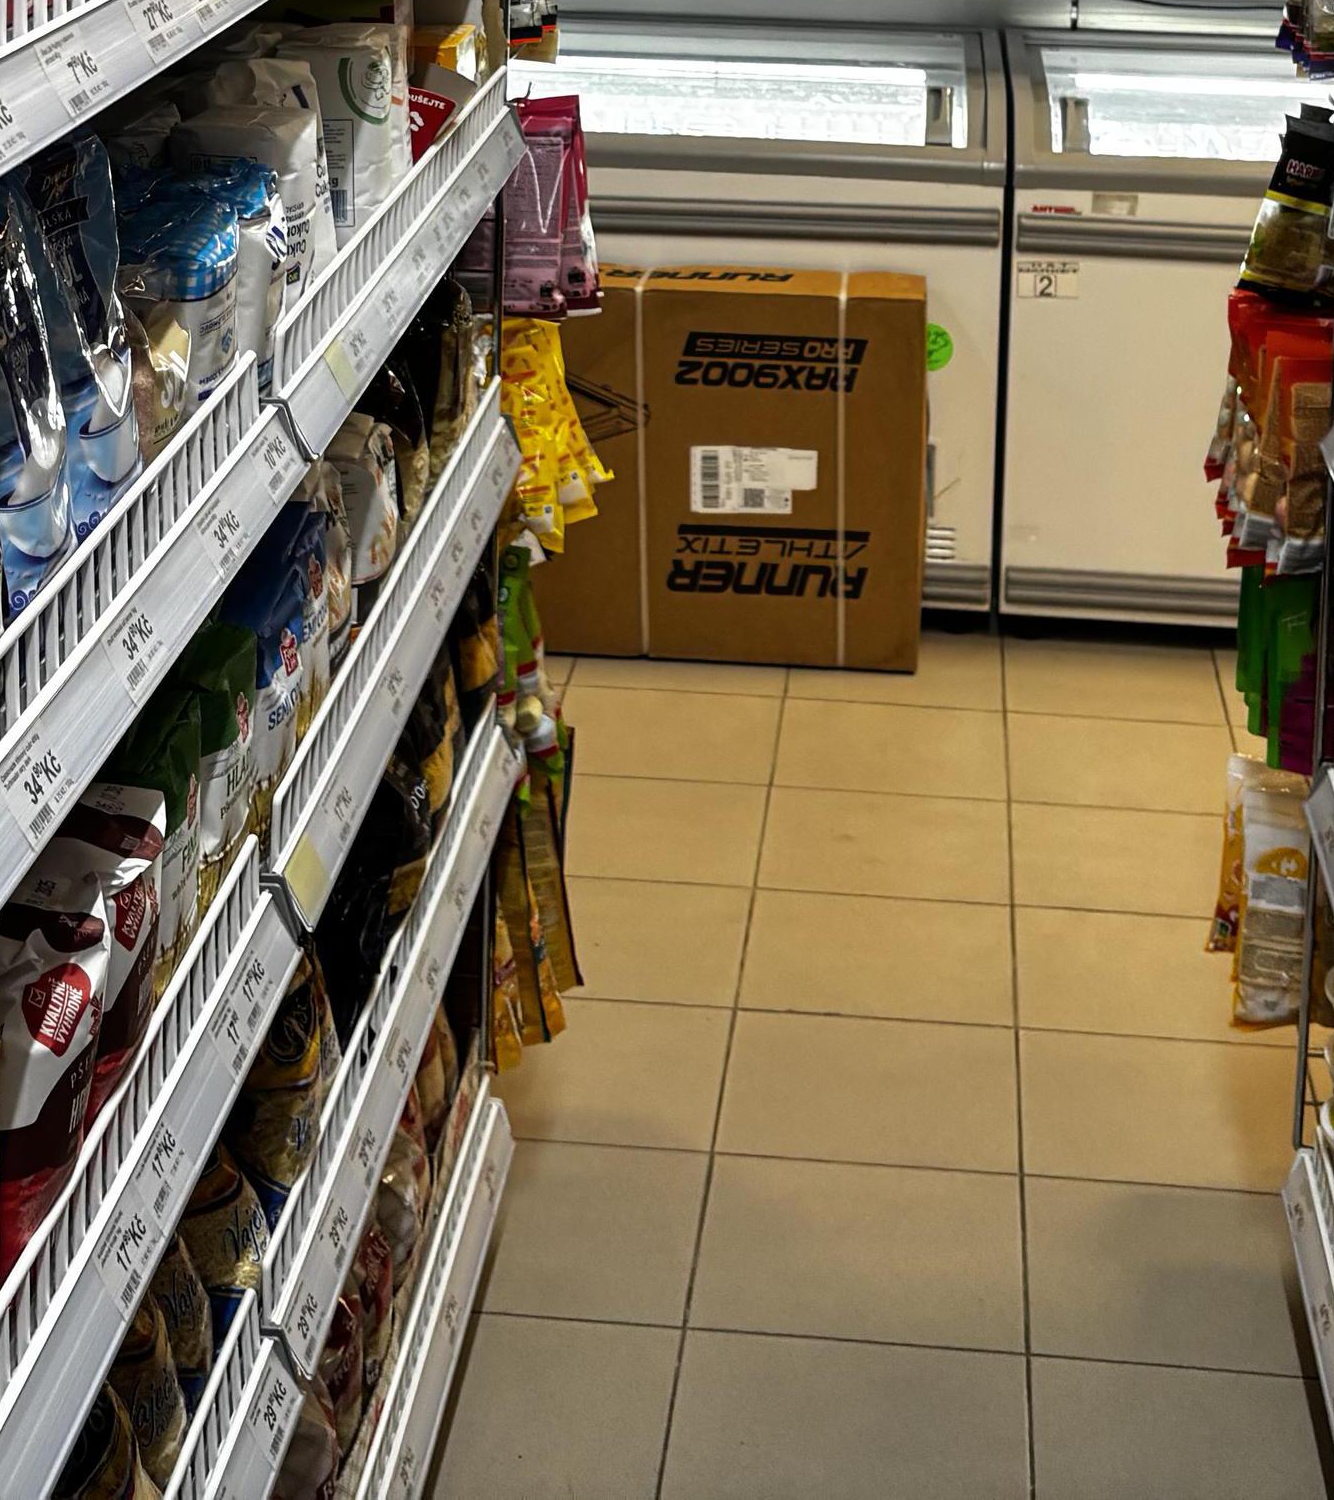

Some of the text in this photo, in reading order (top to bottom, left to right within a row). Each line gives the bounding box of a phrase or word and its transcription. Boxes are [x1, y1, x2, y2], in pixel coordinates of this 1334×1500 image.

[1038, 275, 1054, 298] 2
[695, 338, 803, 357] SERIES
[674, 359, 860, 393] RAX9002
[676, 536, 868, 560] ATHLETIX
[667, 558, 869, 600] RUNNER
